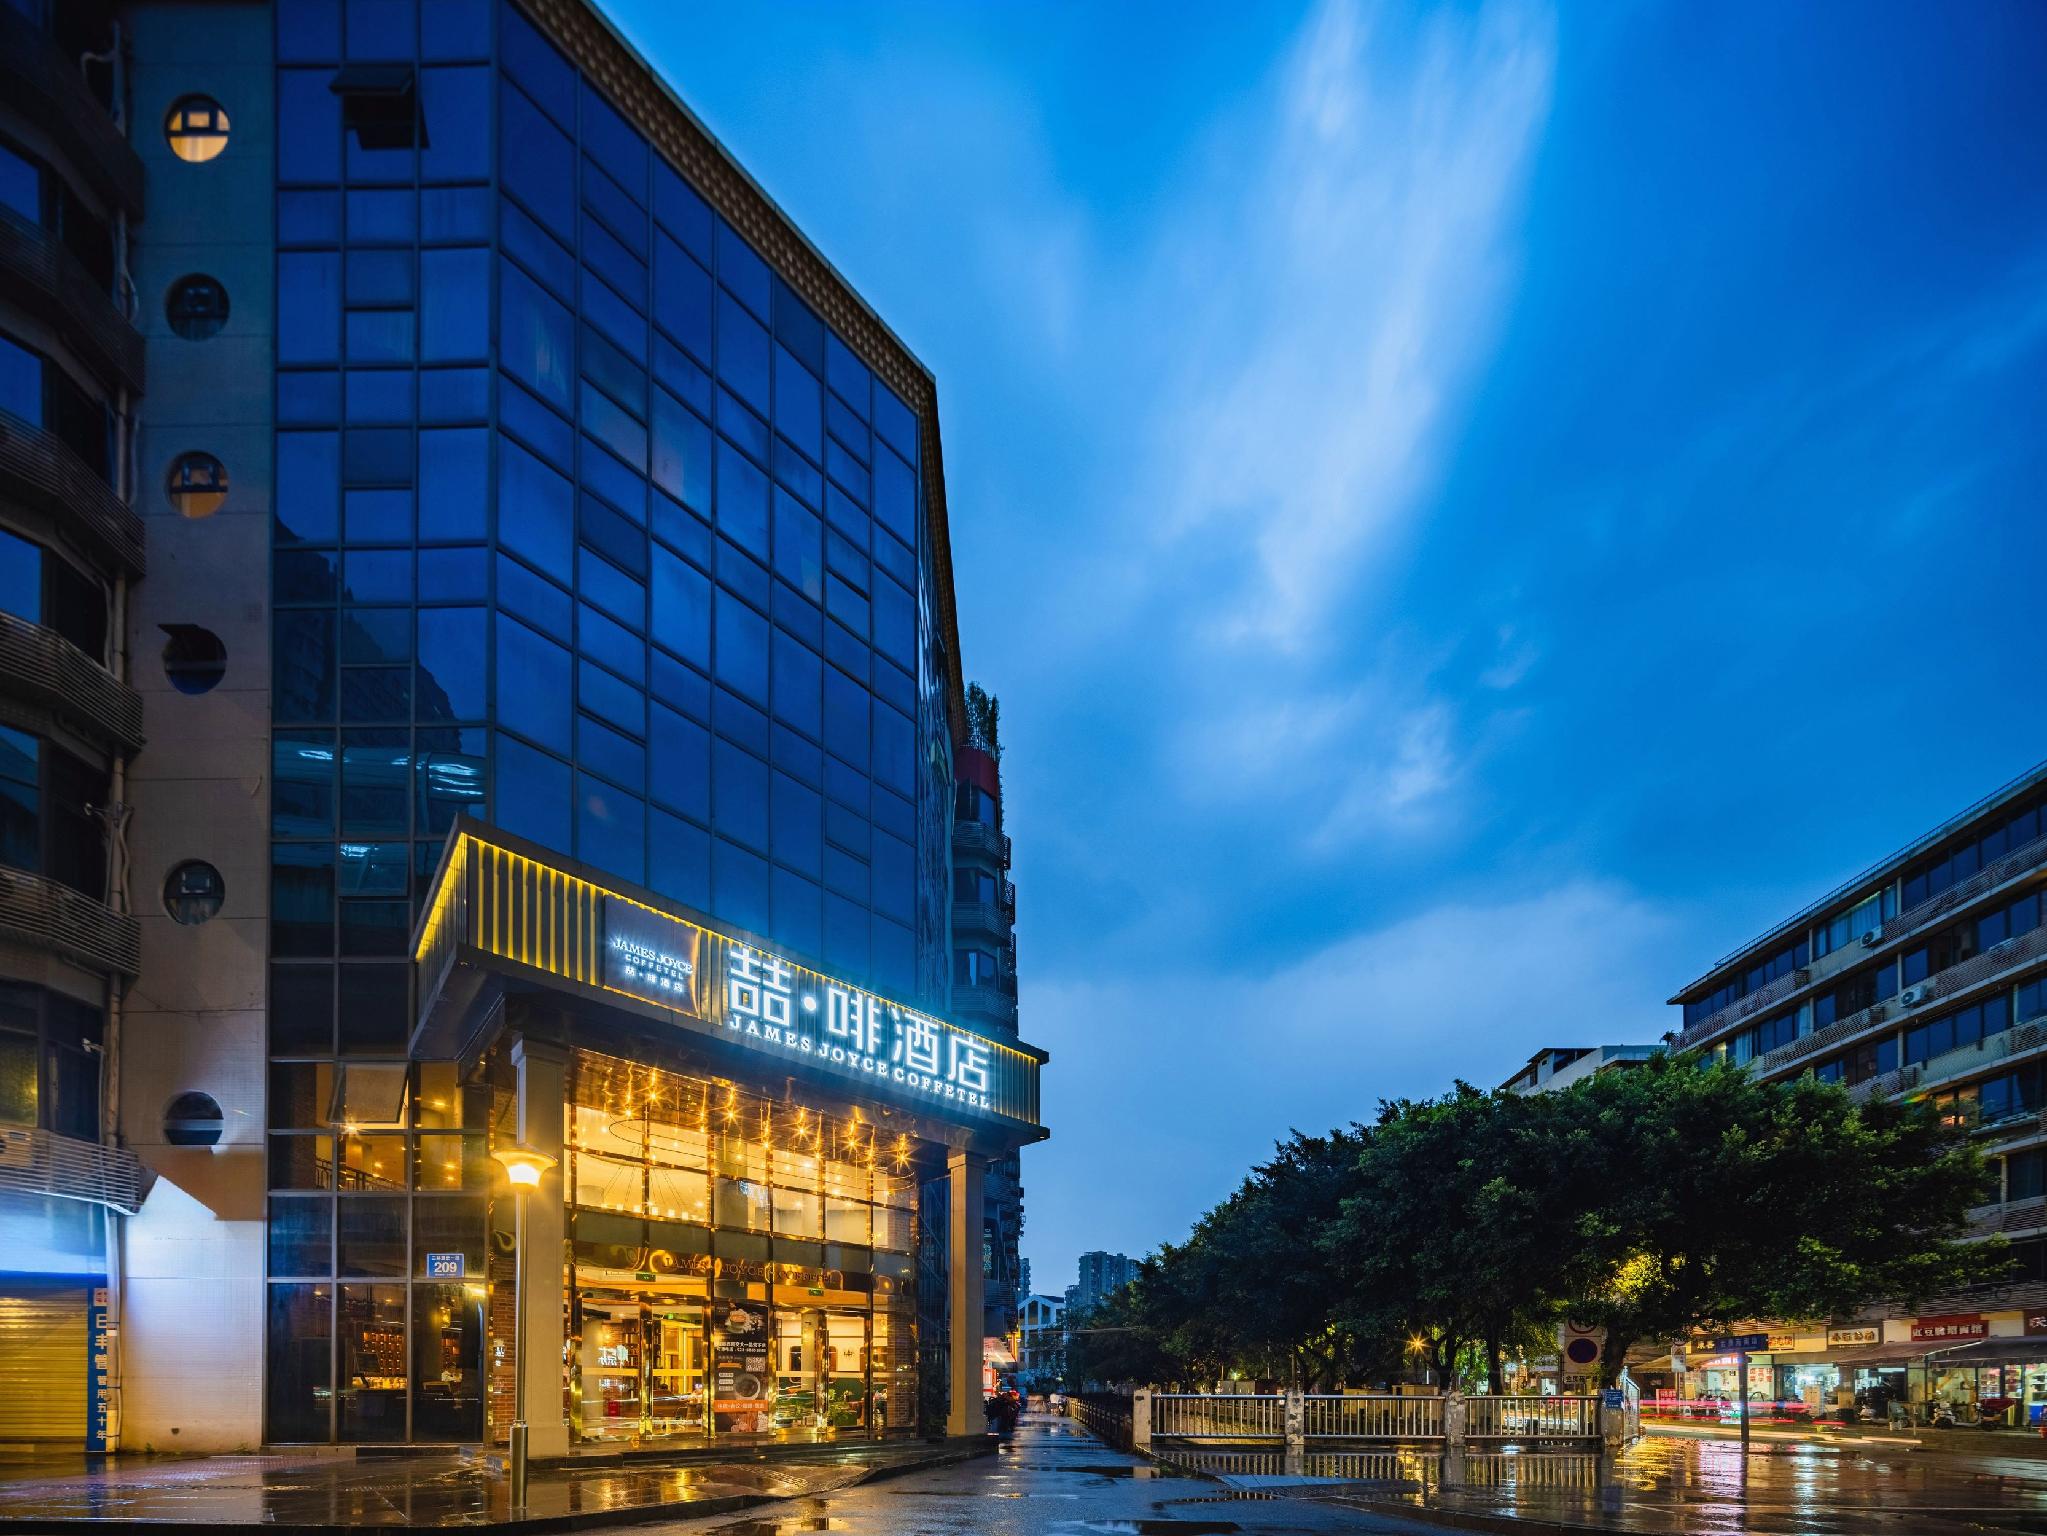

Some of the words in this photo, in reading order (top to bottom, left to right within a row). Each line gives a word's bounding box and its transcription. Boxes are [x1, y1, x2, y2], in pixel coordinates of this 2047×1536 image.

[613, 938, 656, 961] JAMES
[656, 954, 693, 974] JOYCE
[625, 953, 684, 980] COFFETEL
[730, 1014, 810, 1053] JAMES
[818, 1042, 888, 1077] JOYCE
[894, 1066, 990, 1109] COFFETEL
[434, 1261, 457, 1273] 209
